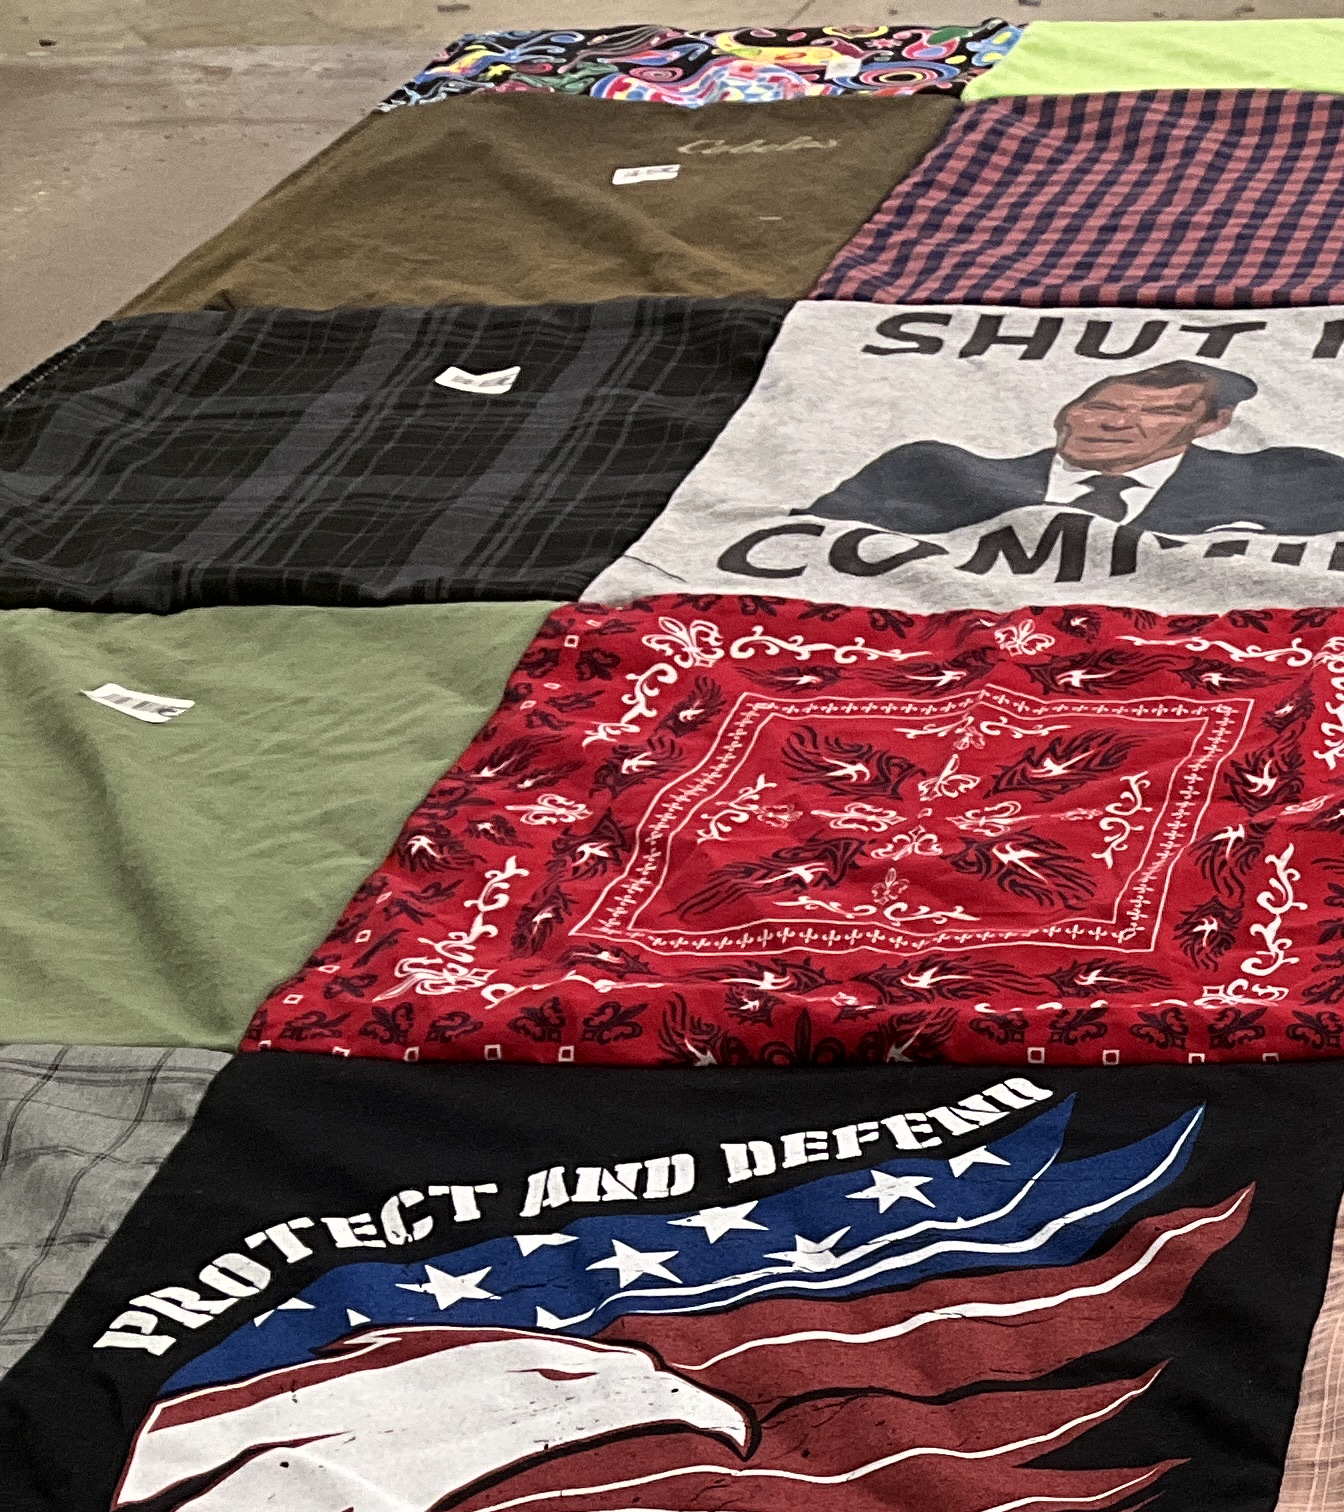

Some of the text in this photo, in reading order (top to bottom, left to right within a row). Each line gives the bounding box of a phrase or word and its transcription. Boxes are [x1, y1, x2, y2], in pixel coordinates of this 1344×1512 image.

[860, 311, 1268, 361] SHUT
[92, 1077, 1054, 1357] PROTECT AND DEFEND
